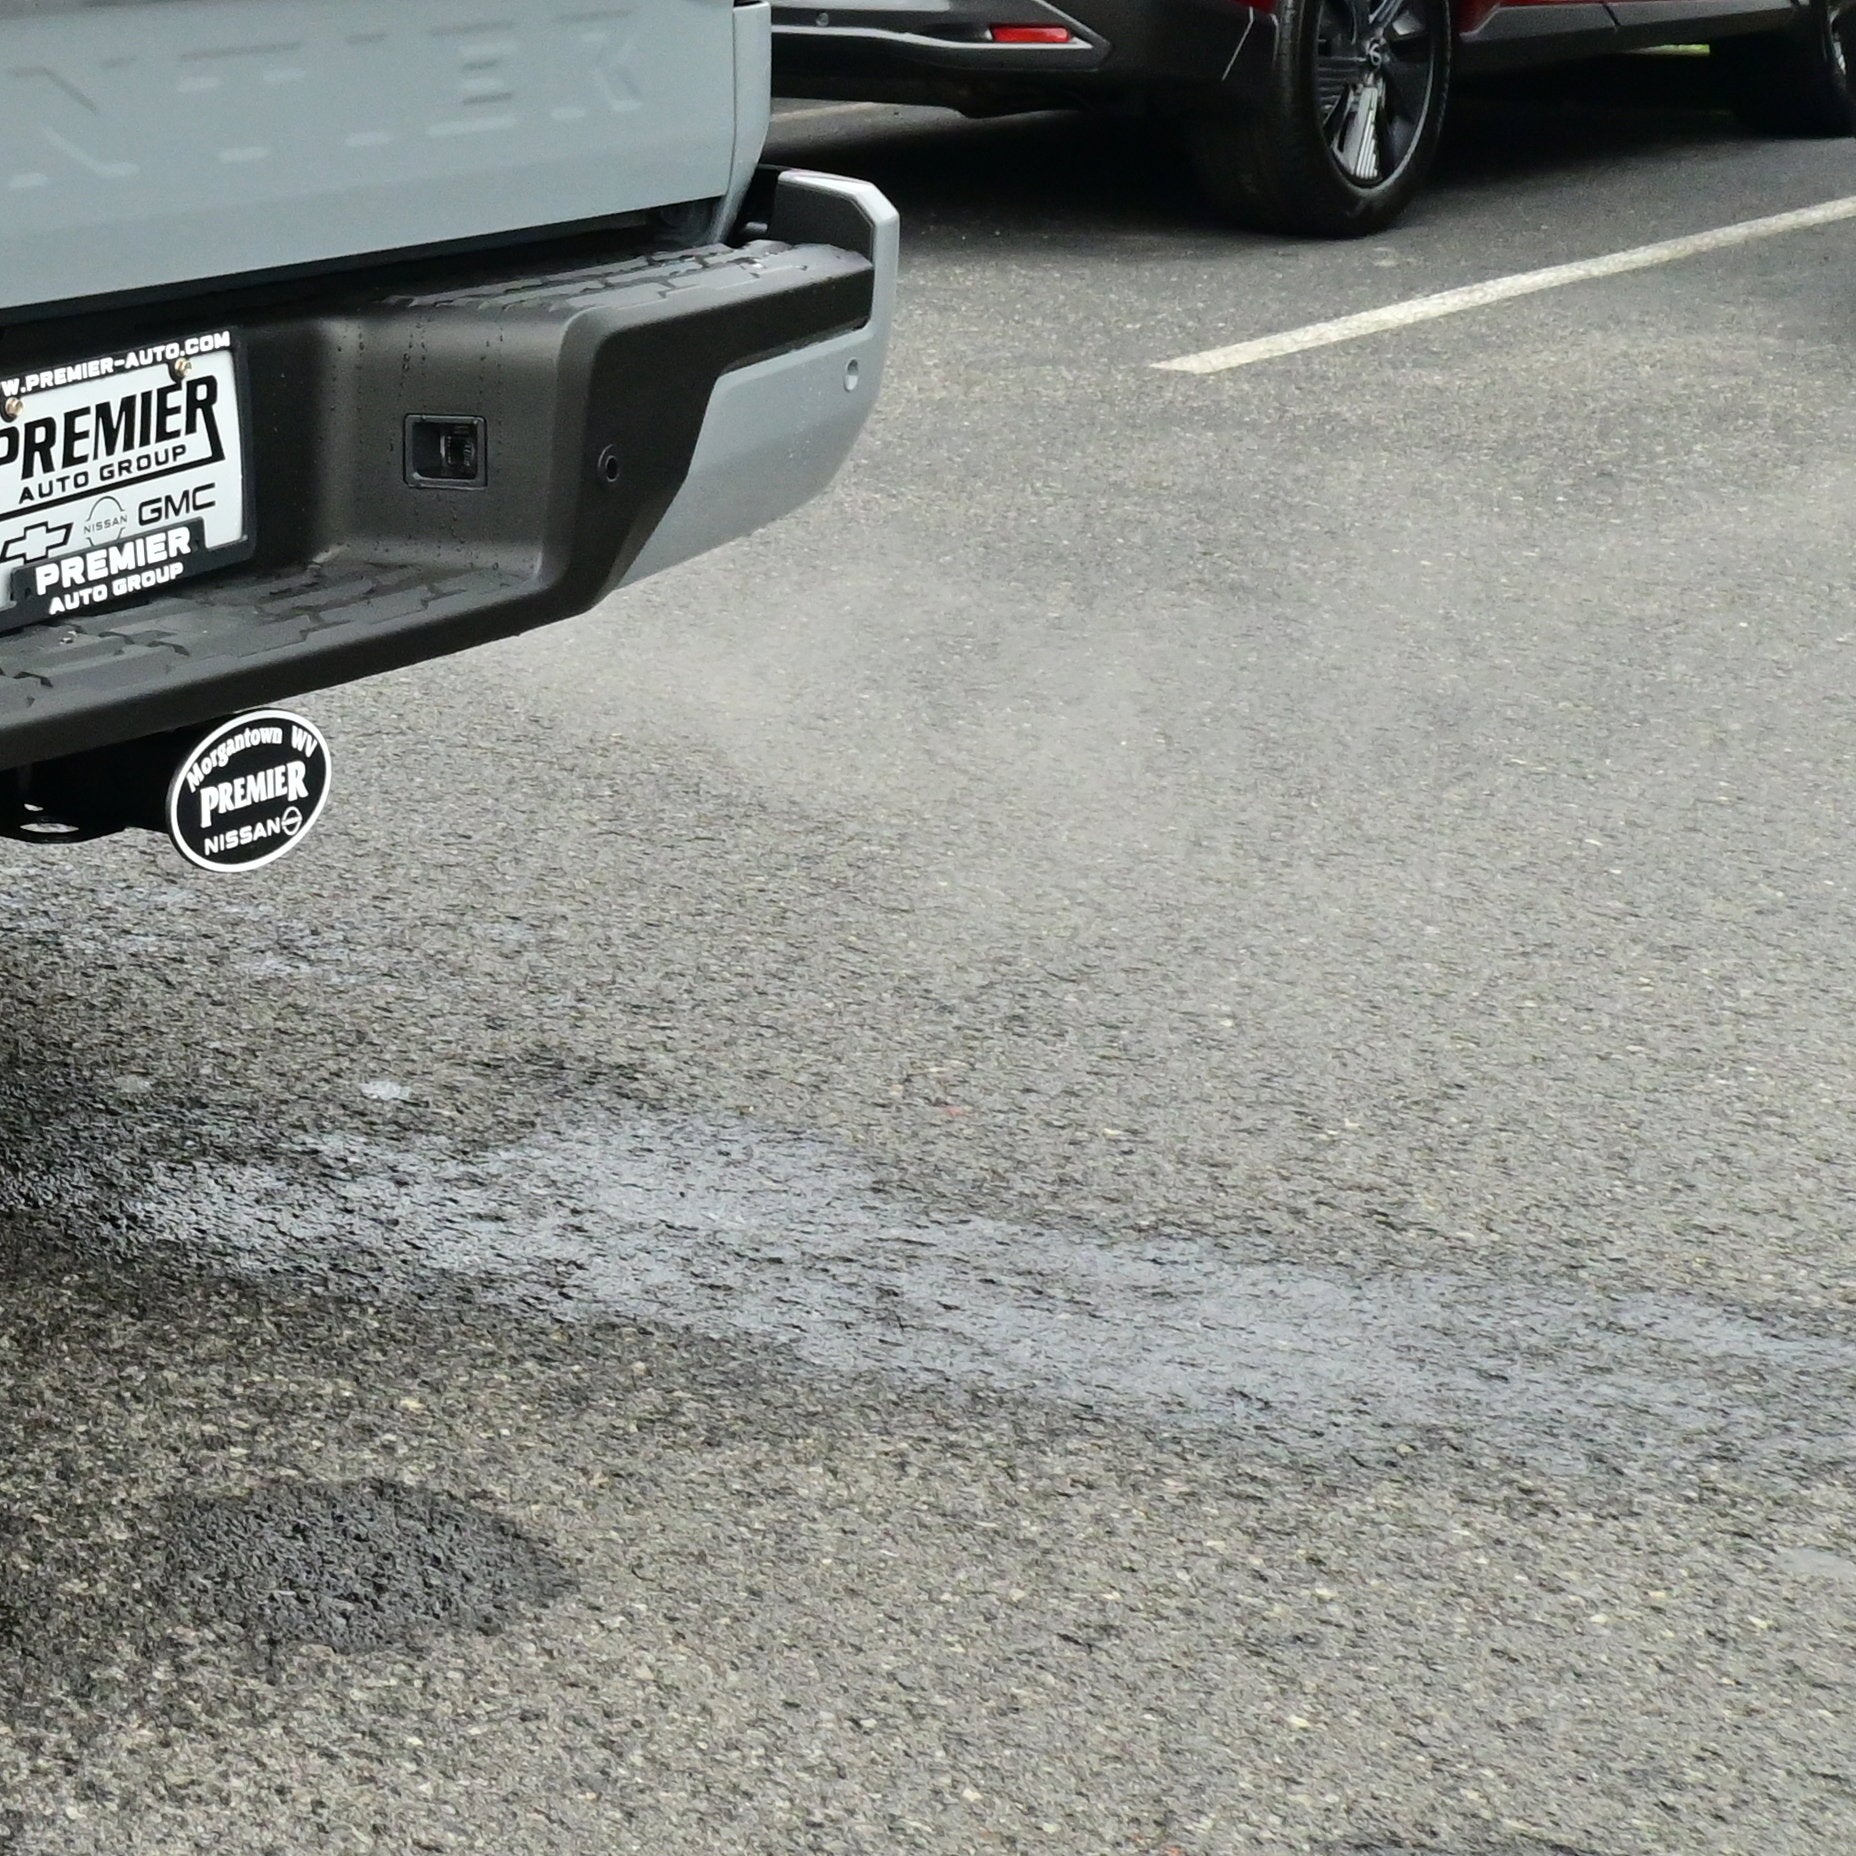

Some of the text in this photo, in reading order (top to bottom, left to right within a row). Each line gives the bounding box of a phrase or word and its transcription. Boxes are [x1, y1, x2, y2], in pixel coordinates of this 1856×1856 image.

[18, 443, 188, 505] AUTO GROUP
[83, 482, 217, 535] NISSAN GMC
[34, 526, 192, 596] PREMIER
[48, 561, 185, 616] AUTO GROUP
[186, 724, 319, 794] Morgantown WV
[200, 760, 310, 829] PREMIER
[203, 816, 281, 856] NISSAN
